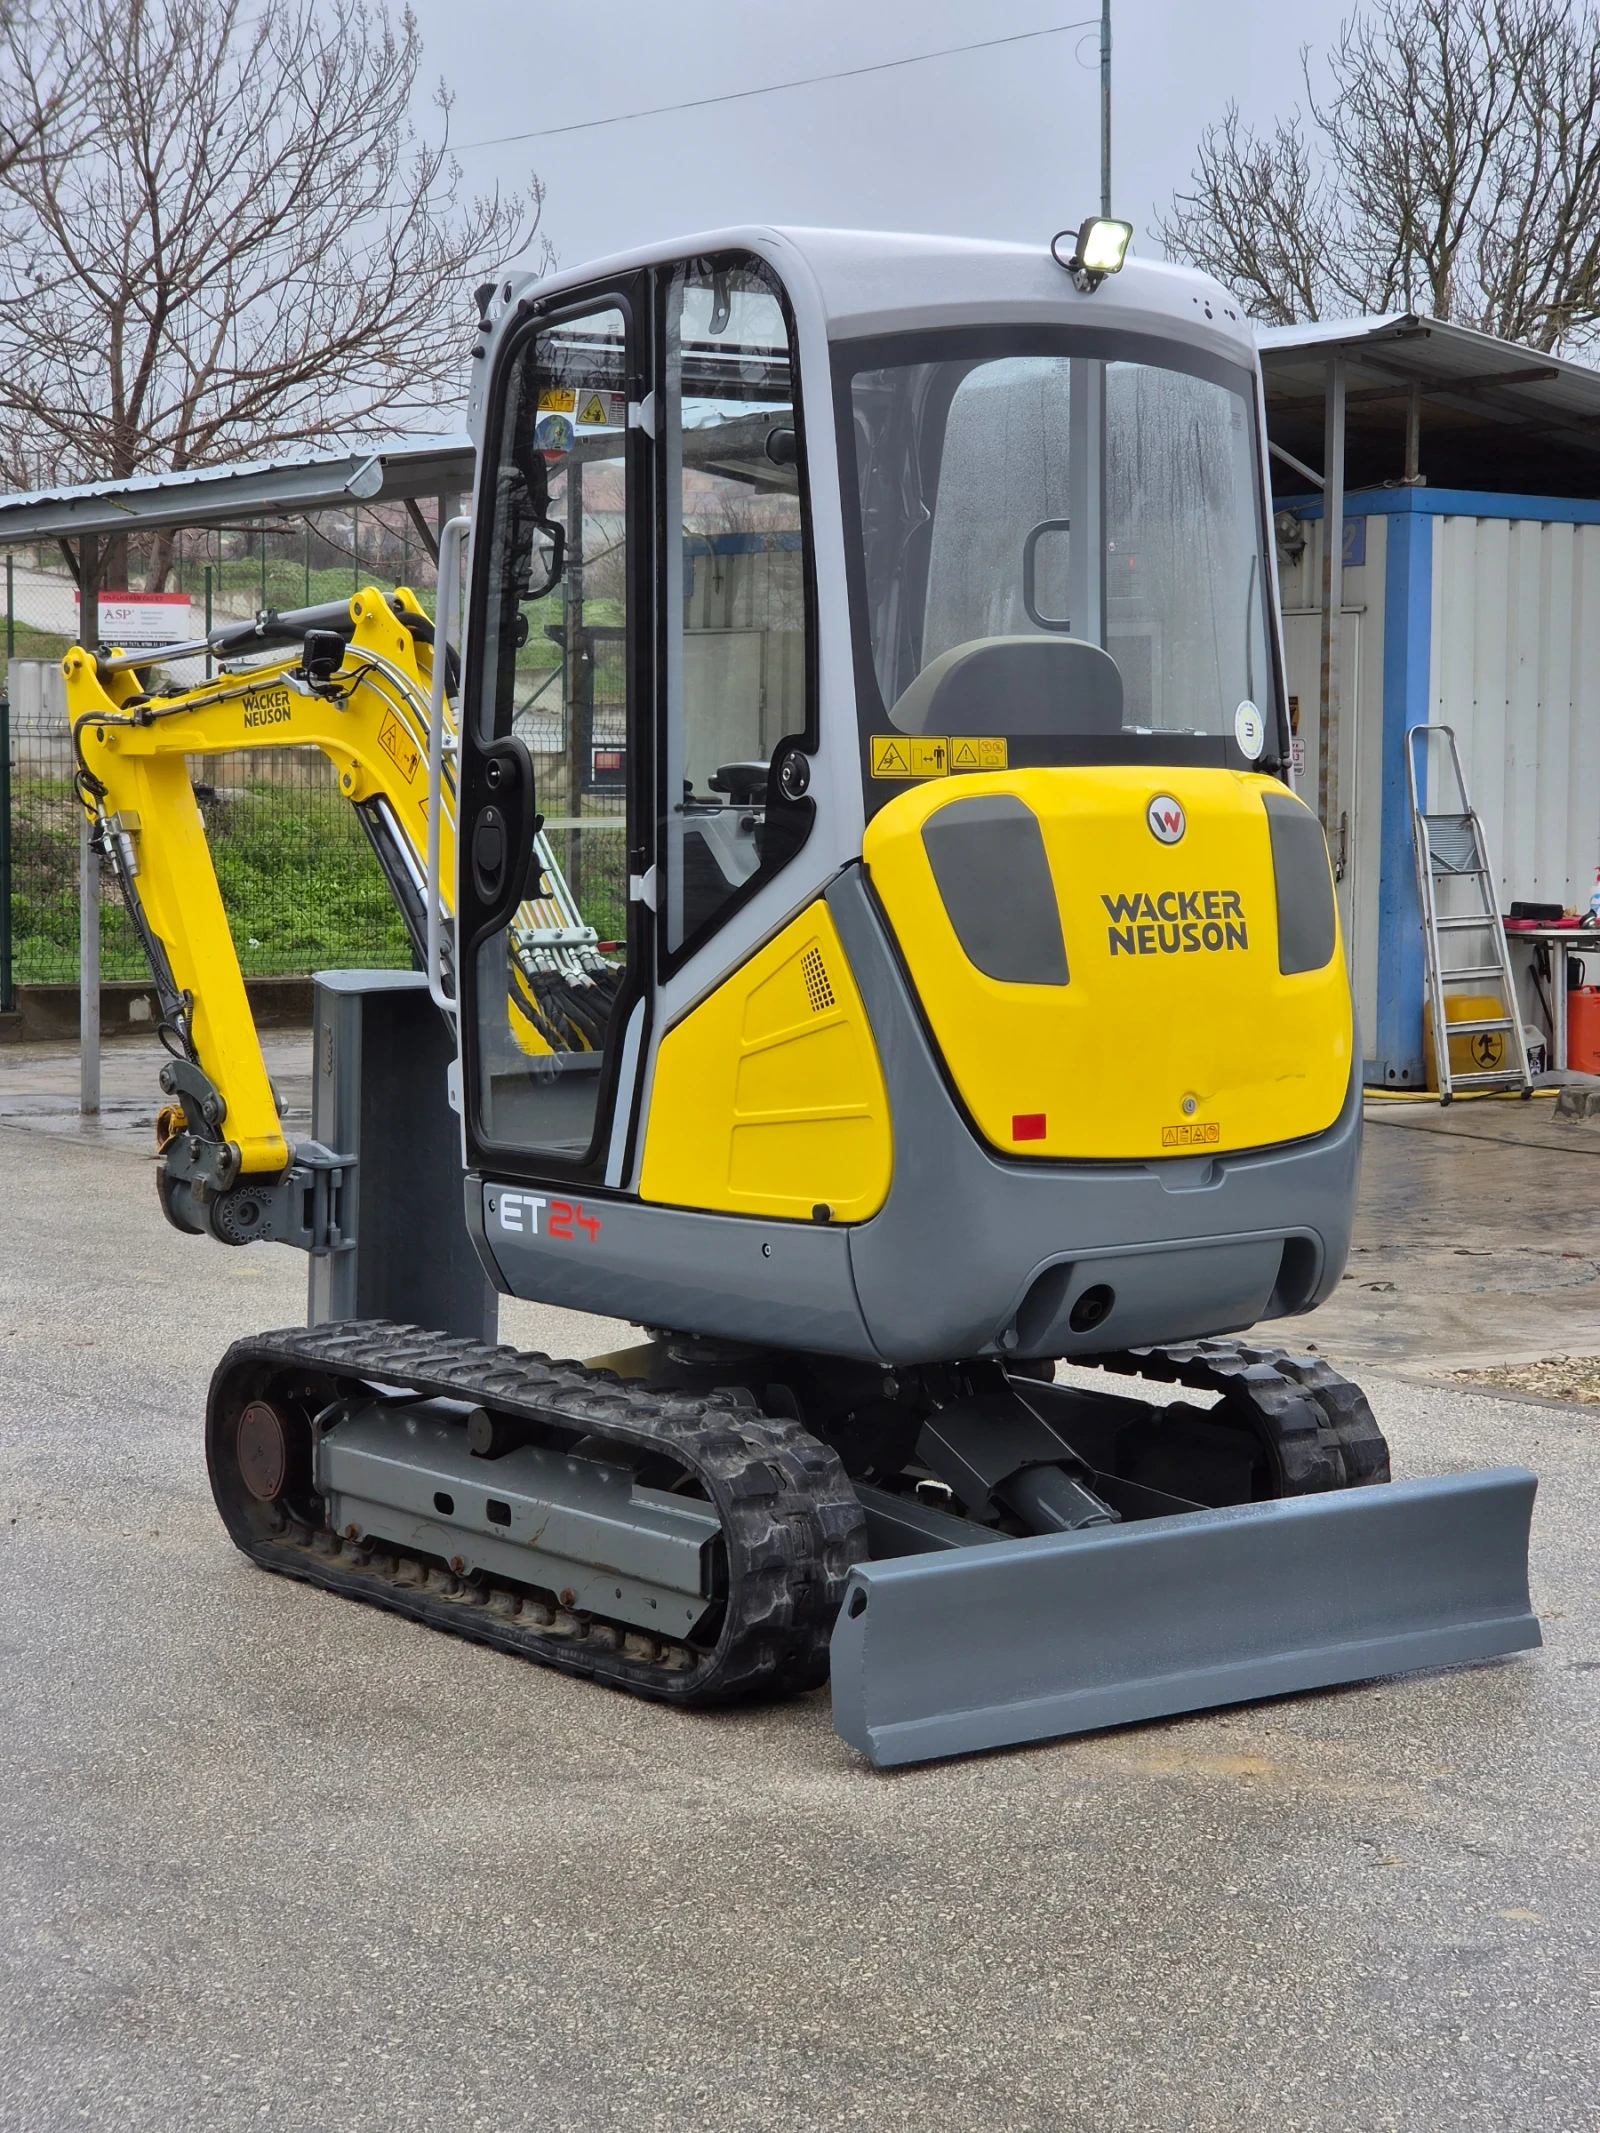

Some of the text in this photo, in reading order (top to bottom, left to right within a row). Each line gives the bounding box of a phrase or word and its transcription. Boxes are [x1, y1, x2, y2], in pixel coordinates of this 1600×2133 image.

[104, 609, 132, 620] ASP
[242, 691, 290, 712] WACKER
[244, 706, 291, 728] NEUSON
[1100, 890, 1245, 923] WACKER
[1107, 921, 1249, 956] NEUSON
[500, 1193, 602, 1243] ET24
